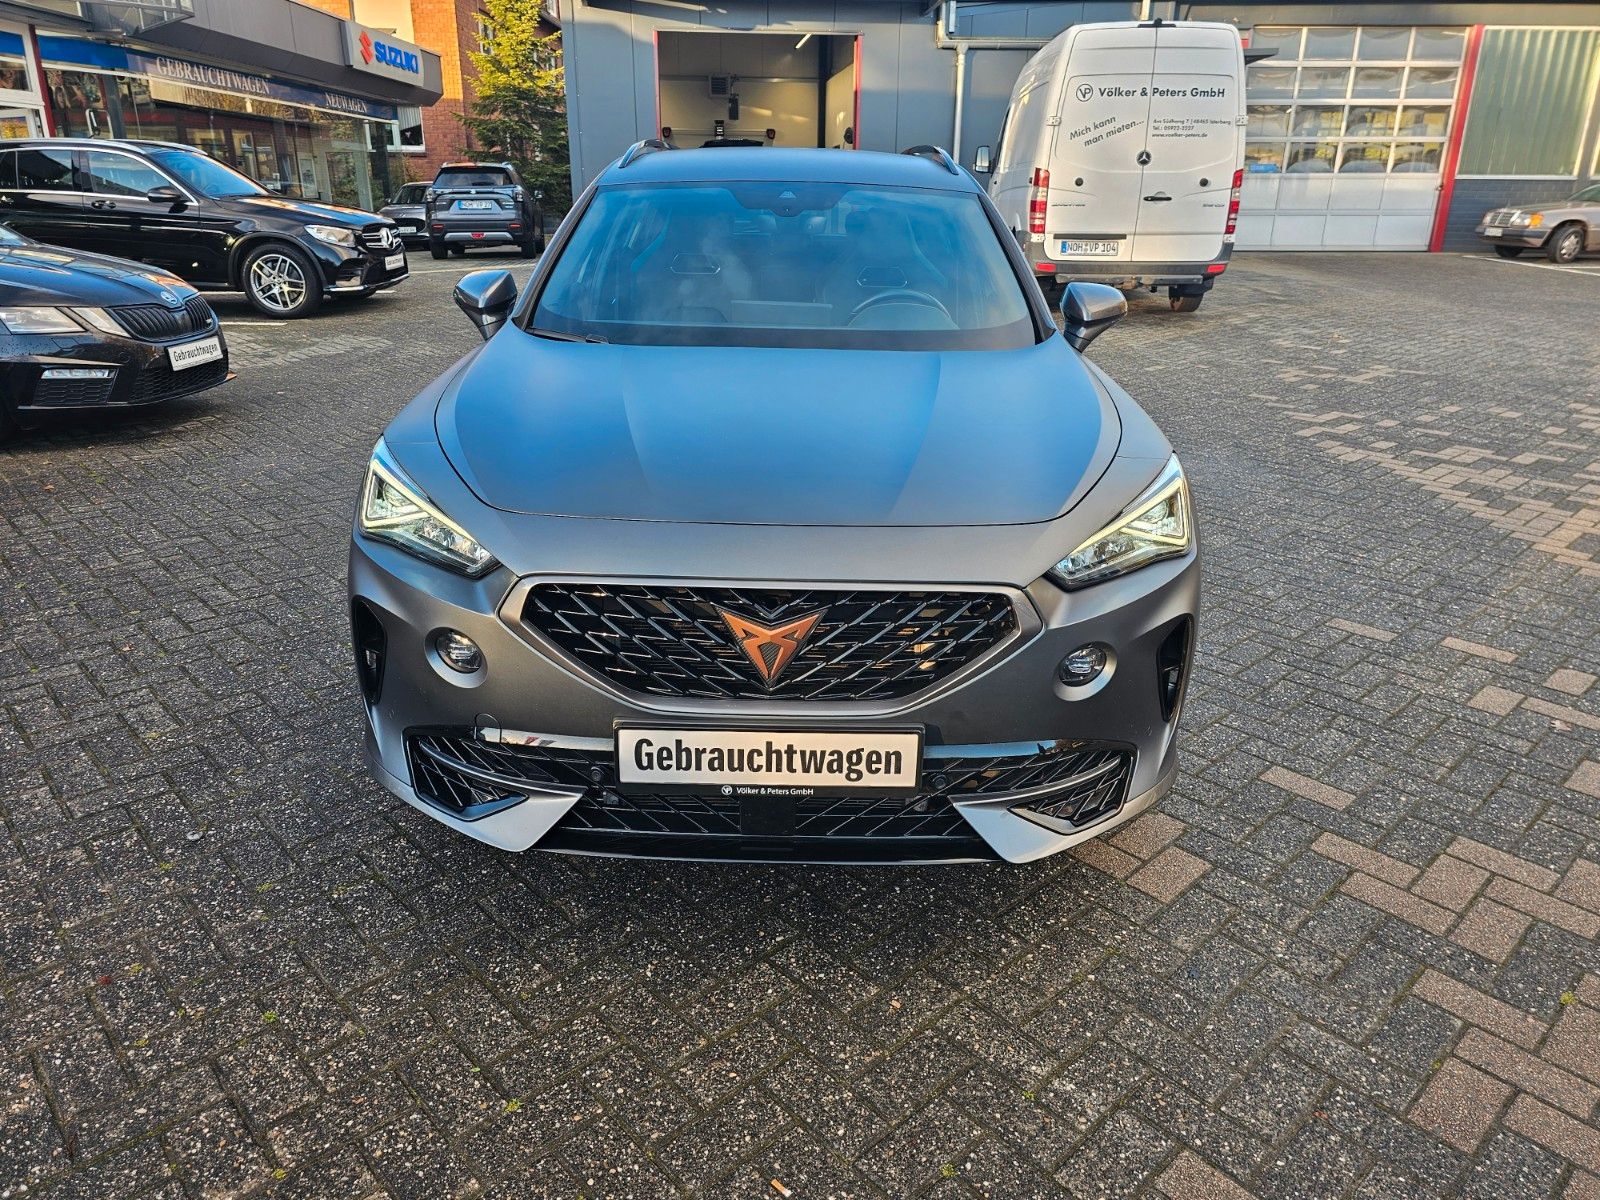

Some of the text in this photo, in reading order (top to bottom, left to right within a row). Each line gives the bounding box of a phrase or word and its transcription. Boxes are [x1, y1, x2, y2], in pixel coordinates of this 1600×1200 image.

[374, 40, 419, 74] SUZUKI
[156, 56, 270, 94] GEBRAUCHTWAGEN
[324, 92, 368, 113] NEUWAGEN
[1098, 87, 1136, 97] Völker
[1139, 87, 1148, 97] &
[1152, 87, 1187, 97] Peters
[1190, 88, 1225, 98] GmbH
[1069, 116, 1116, 140] Mich kann
[1084, 134, 1104, 147] man
[1068, 243, 1116, 253] NOH VP 104
[173, 343, 218, 362] Gebrauchtwagen
[634, 738, 902, 782] Gebrauchtwagen
[736, 786, 759, 795] Völker
[760, 787, 766, 795] &
[767, 787, 789, 795] Peters
[790, 788, 814, 796] GmbH
